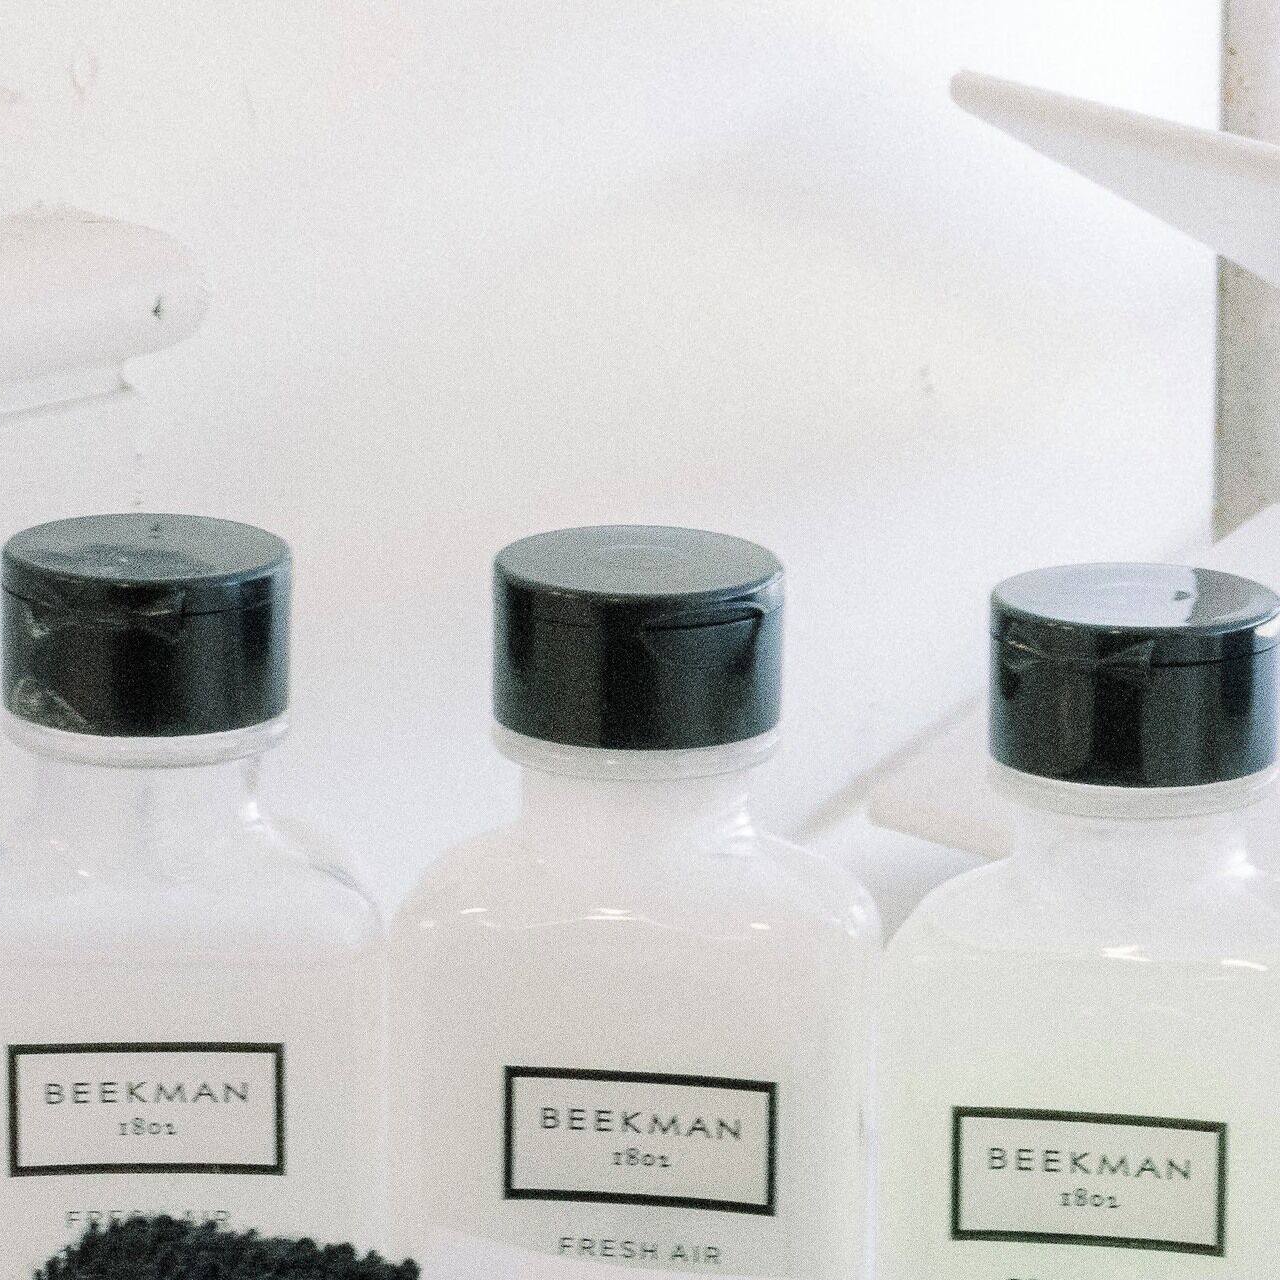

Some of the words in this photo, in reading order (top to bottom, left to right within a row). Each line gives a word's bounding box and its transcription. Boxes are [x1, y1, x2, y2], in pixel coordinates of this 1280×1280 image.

[44, 1079, 250, 1106] BEEKMAN
[539, 1105, 742, 1140] BEEKMAN
[986, 1146, 1193, 1182] BEEKMAN
[558, 1236, 659, 1261] FRESH
[670, 1244, 722, 1265] AIR
